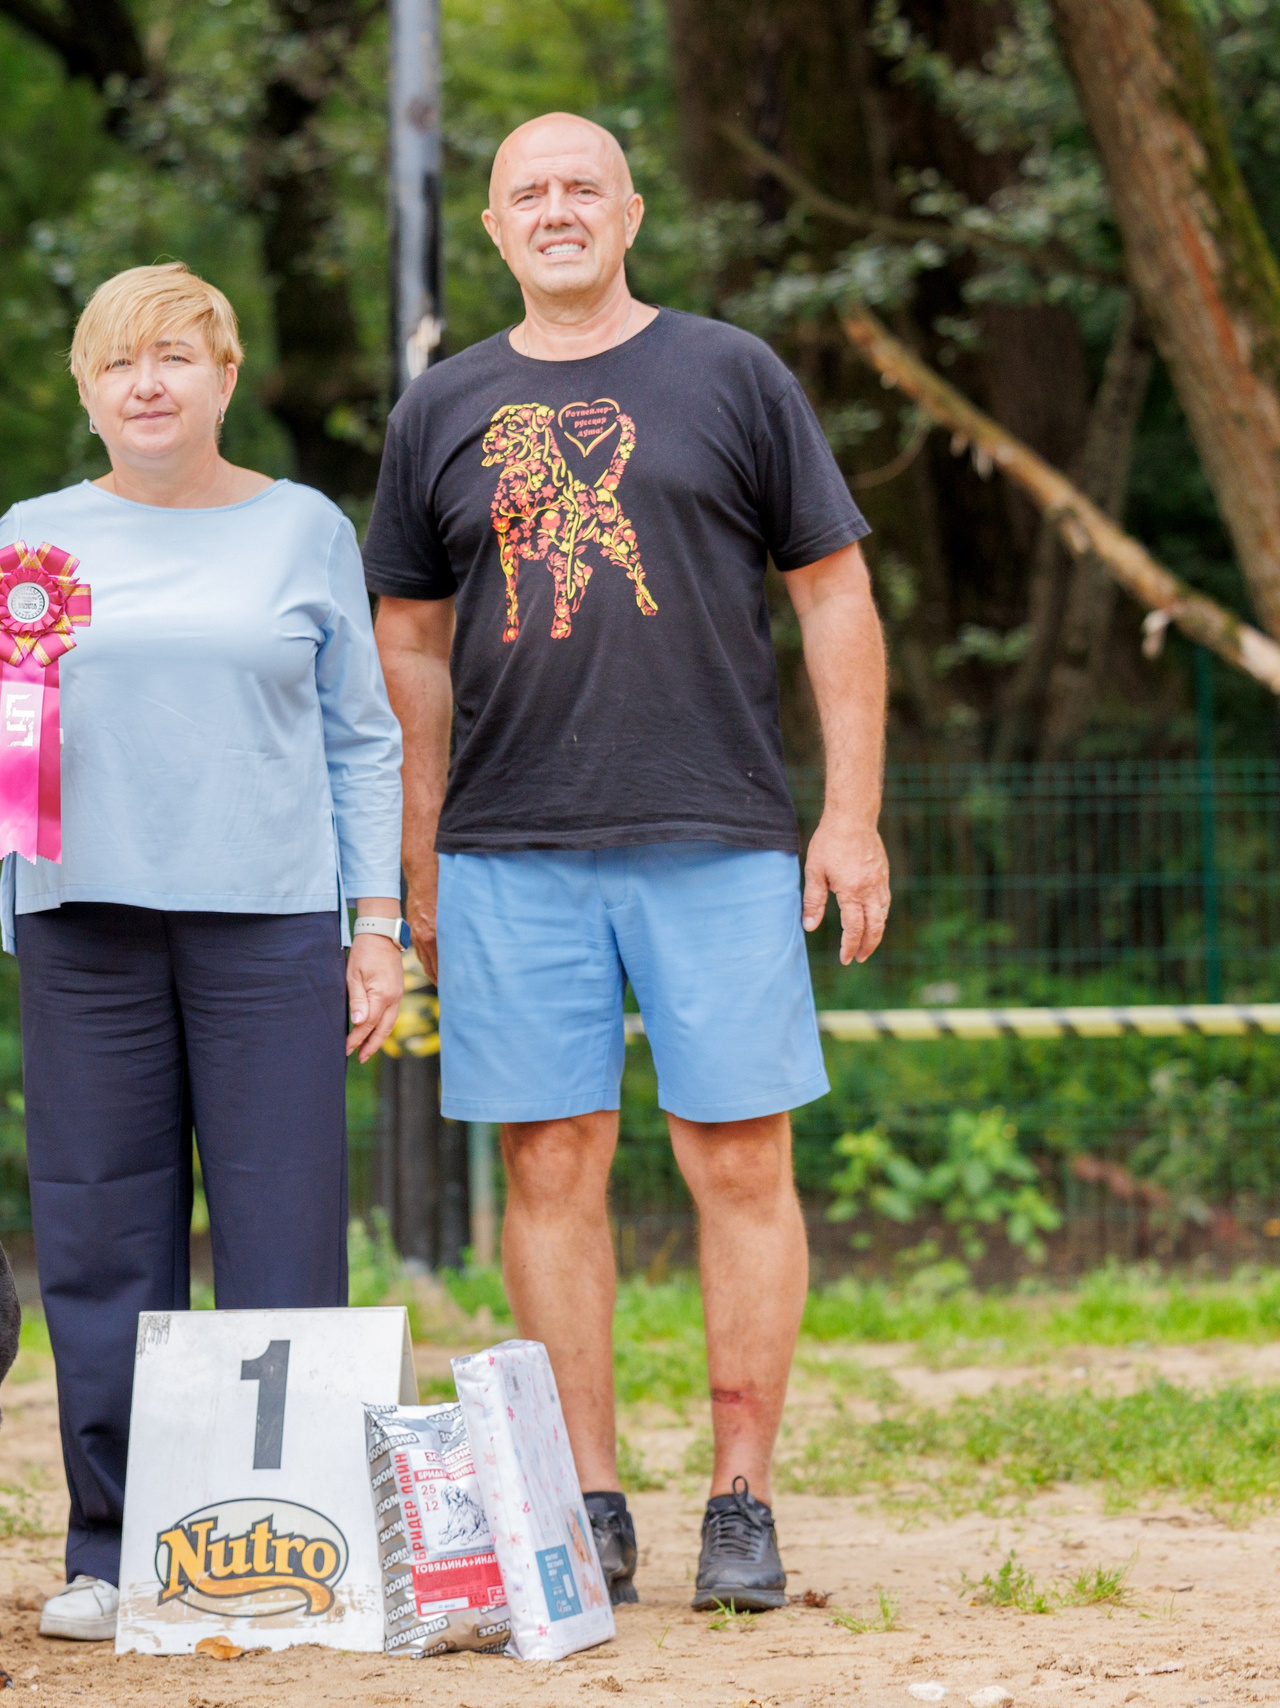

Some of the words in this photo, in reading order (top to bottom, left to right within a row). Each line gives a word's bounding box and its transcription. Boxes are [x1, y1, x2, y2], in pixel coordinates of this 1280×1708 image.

[240, 1340, 290, 1470] 1
[394, 1453, 414, 1495] ЛАЙН
[421, 1484, 436, 1496] 25
[404, 1500, 427, 1560] БРИДЕР
[425, 1501, 439, 1511] 12
[157, 1515, 342, 1606] Nutro
